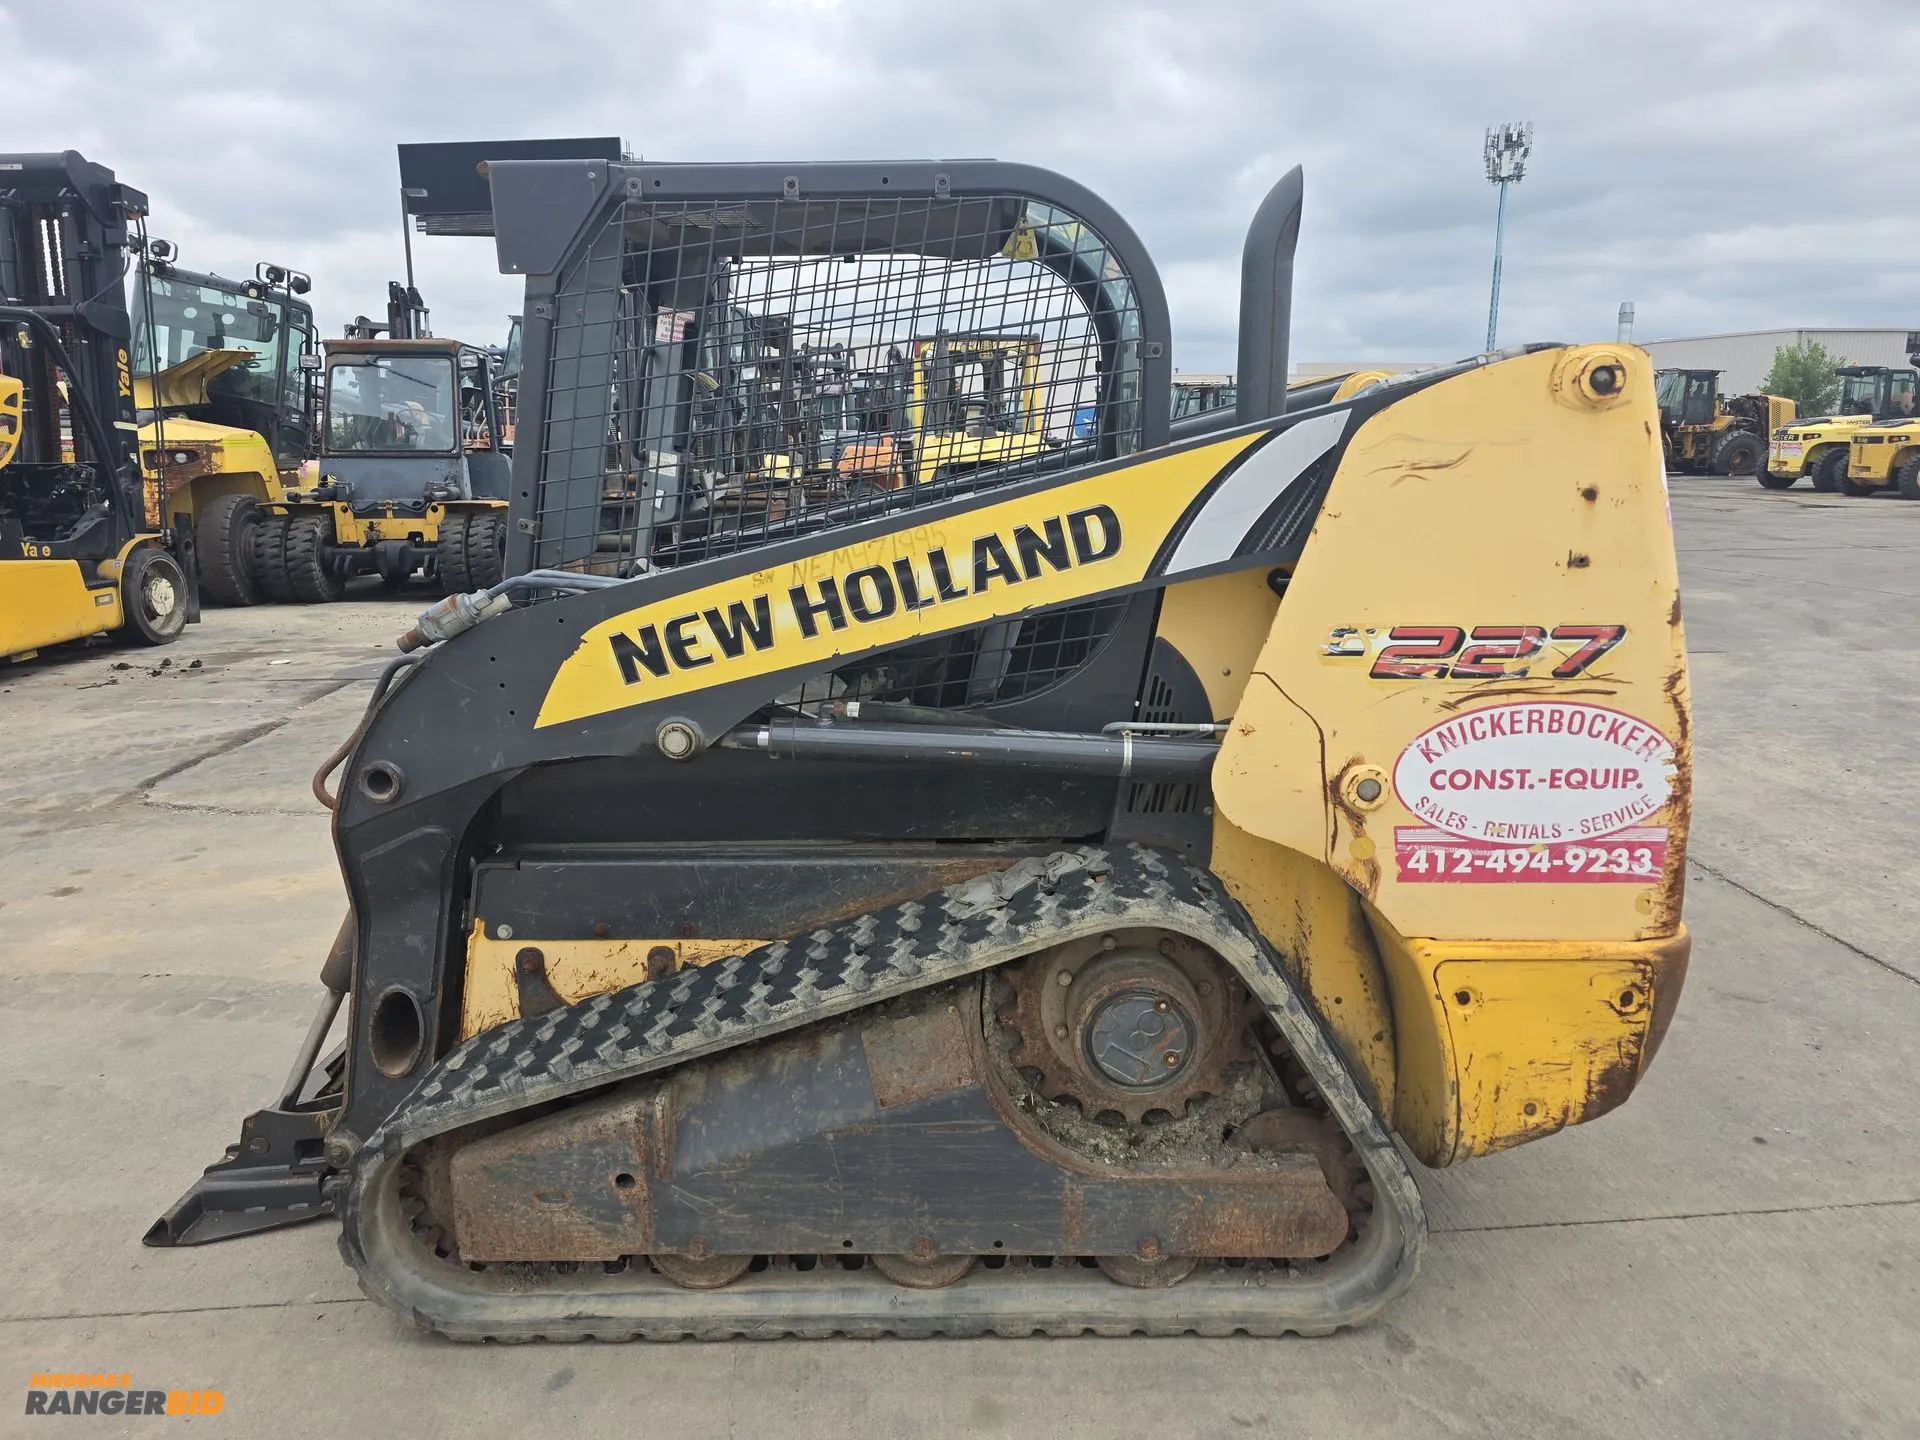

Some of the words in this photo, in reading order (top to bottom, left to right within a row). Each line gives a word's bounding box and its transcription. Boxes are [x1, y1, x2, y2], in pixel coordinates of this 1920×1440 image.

[117, 348, 131, 397] Yale
[21, 542, 51, 557] Yae
[608, 592, 774, 686] NEW
[788, 503, 1123, 639] HOLLAND
[1416, 709, 1662, 764] KNICKERBOCKER
[1415, 796, 1468, 831] SALES
[1483, 820, 1562, 840] RENTALS
[1580, 793, 1656, 835] SERVICE
[1407, 847, 1653, 873] 412-494-9233
